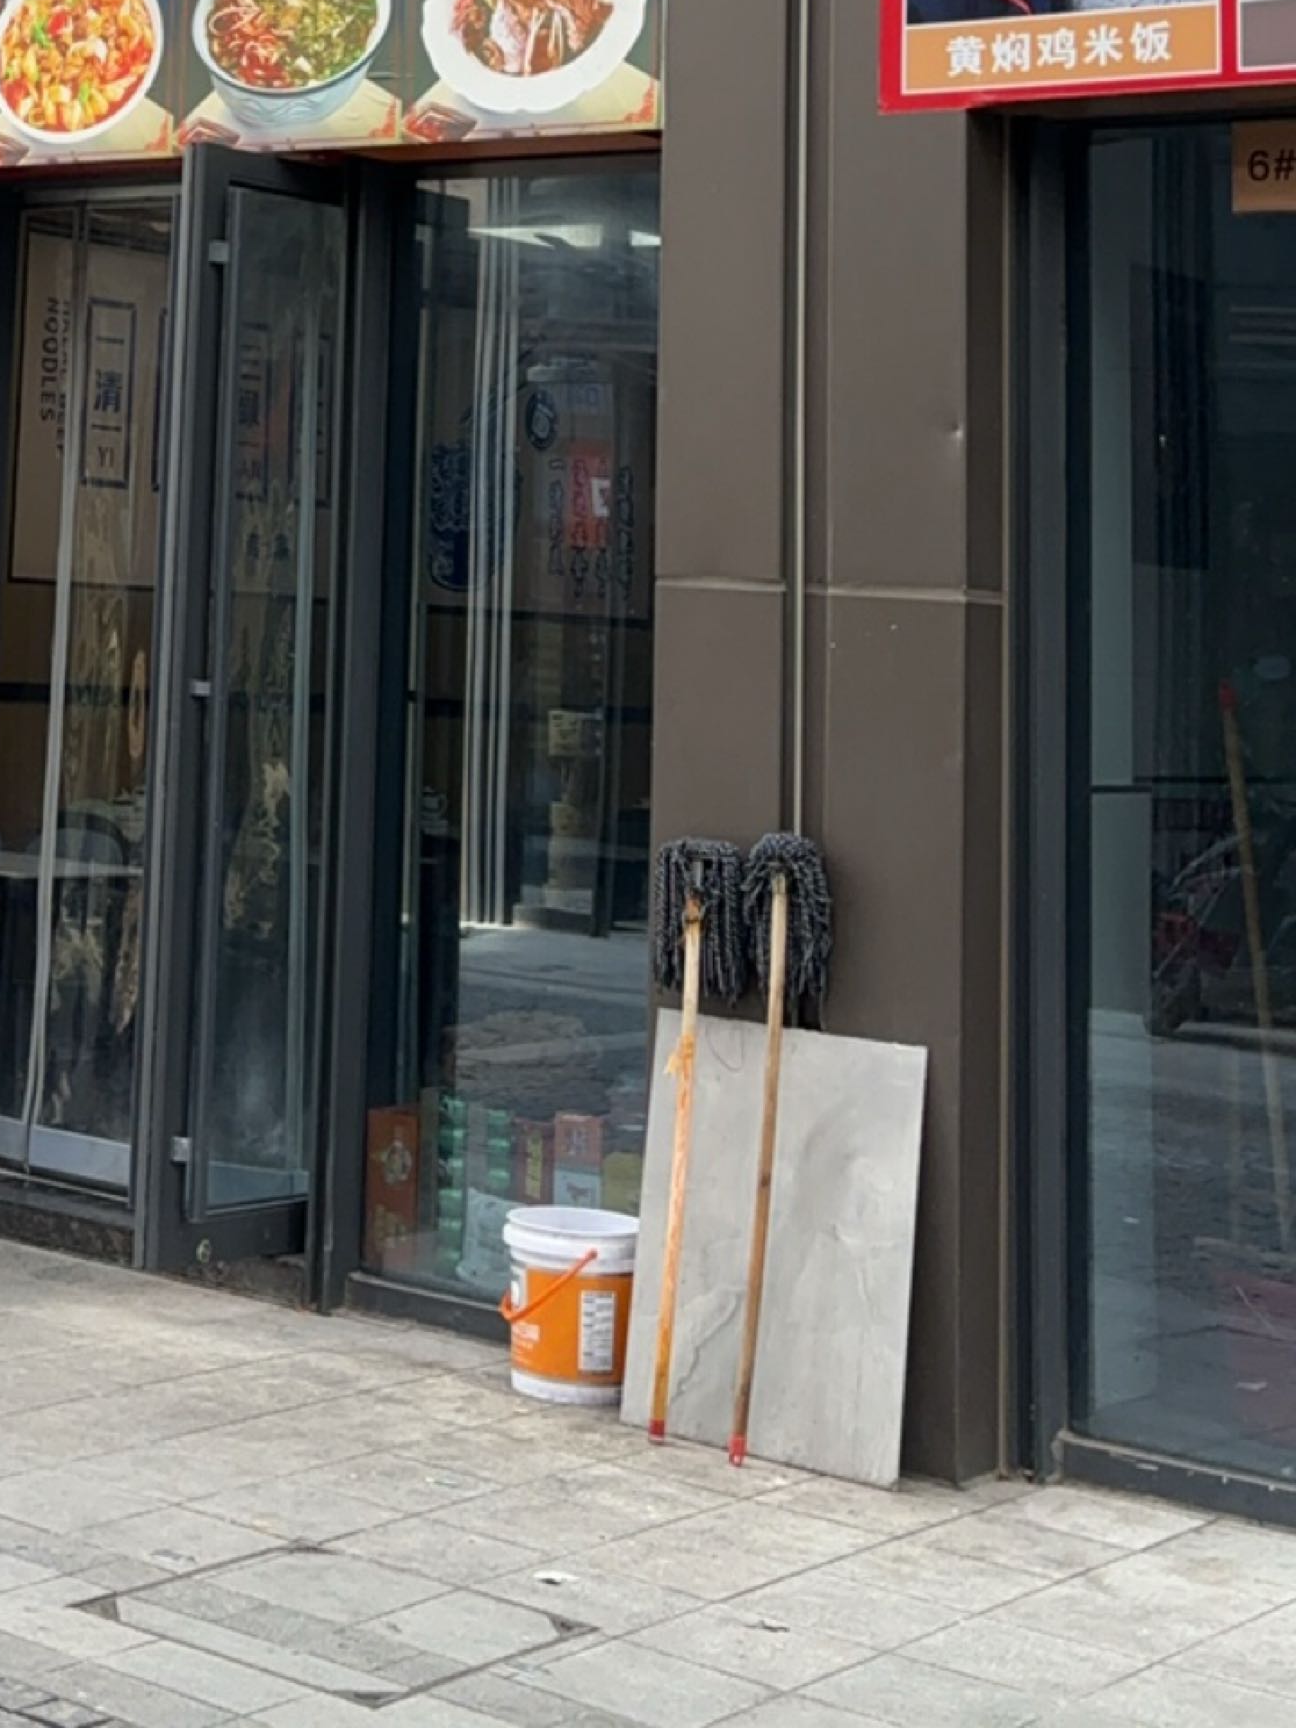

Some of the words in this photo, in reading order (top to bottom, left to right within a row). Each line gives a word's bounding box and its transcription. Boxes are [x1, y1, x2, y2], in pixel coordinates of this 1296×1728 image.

[945, 20, 1172, 77] 黄焖鸡米饭
